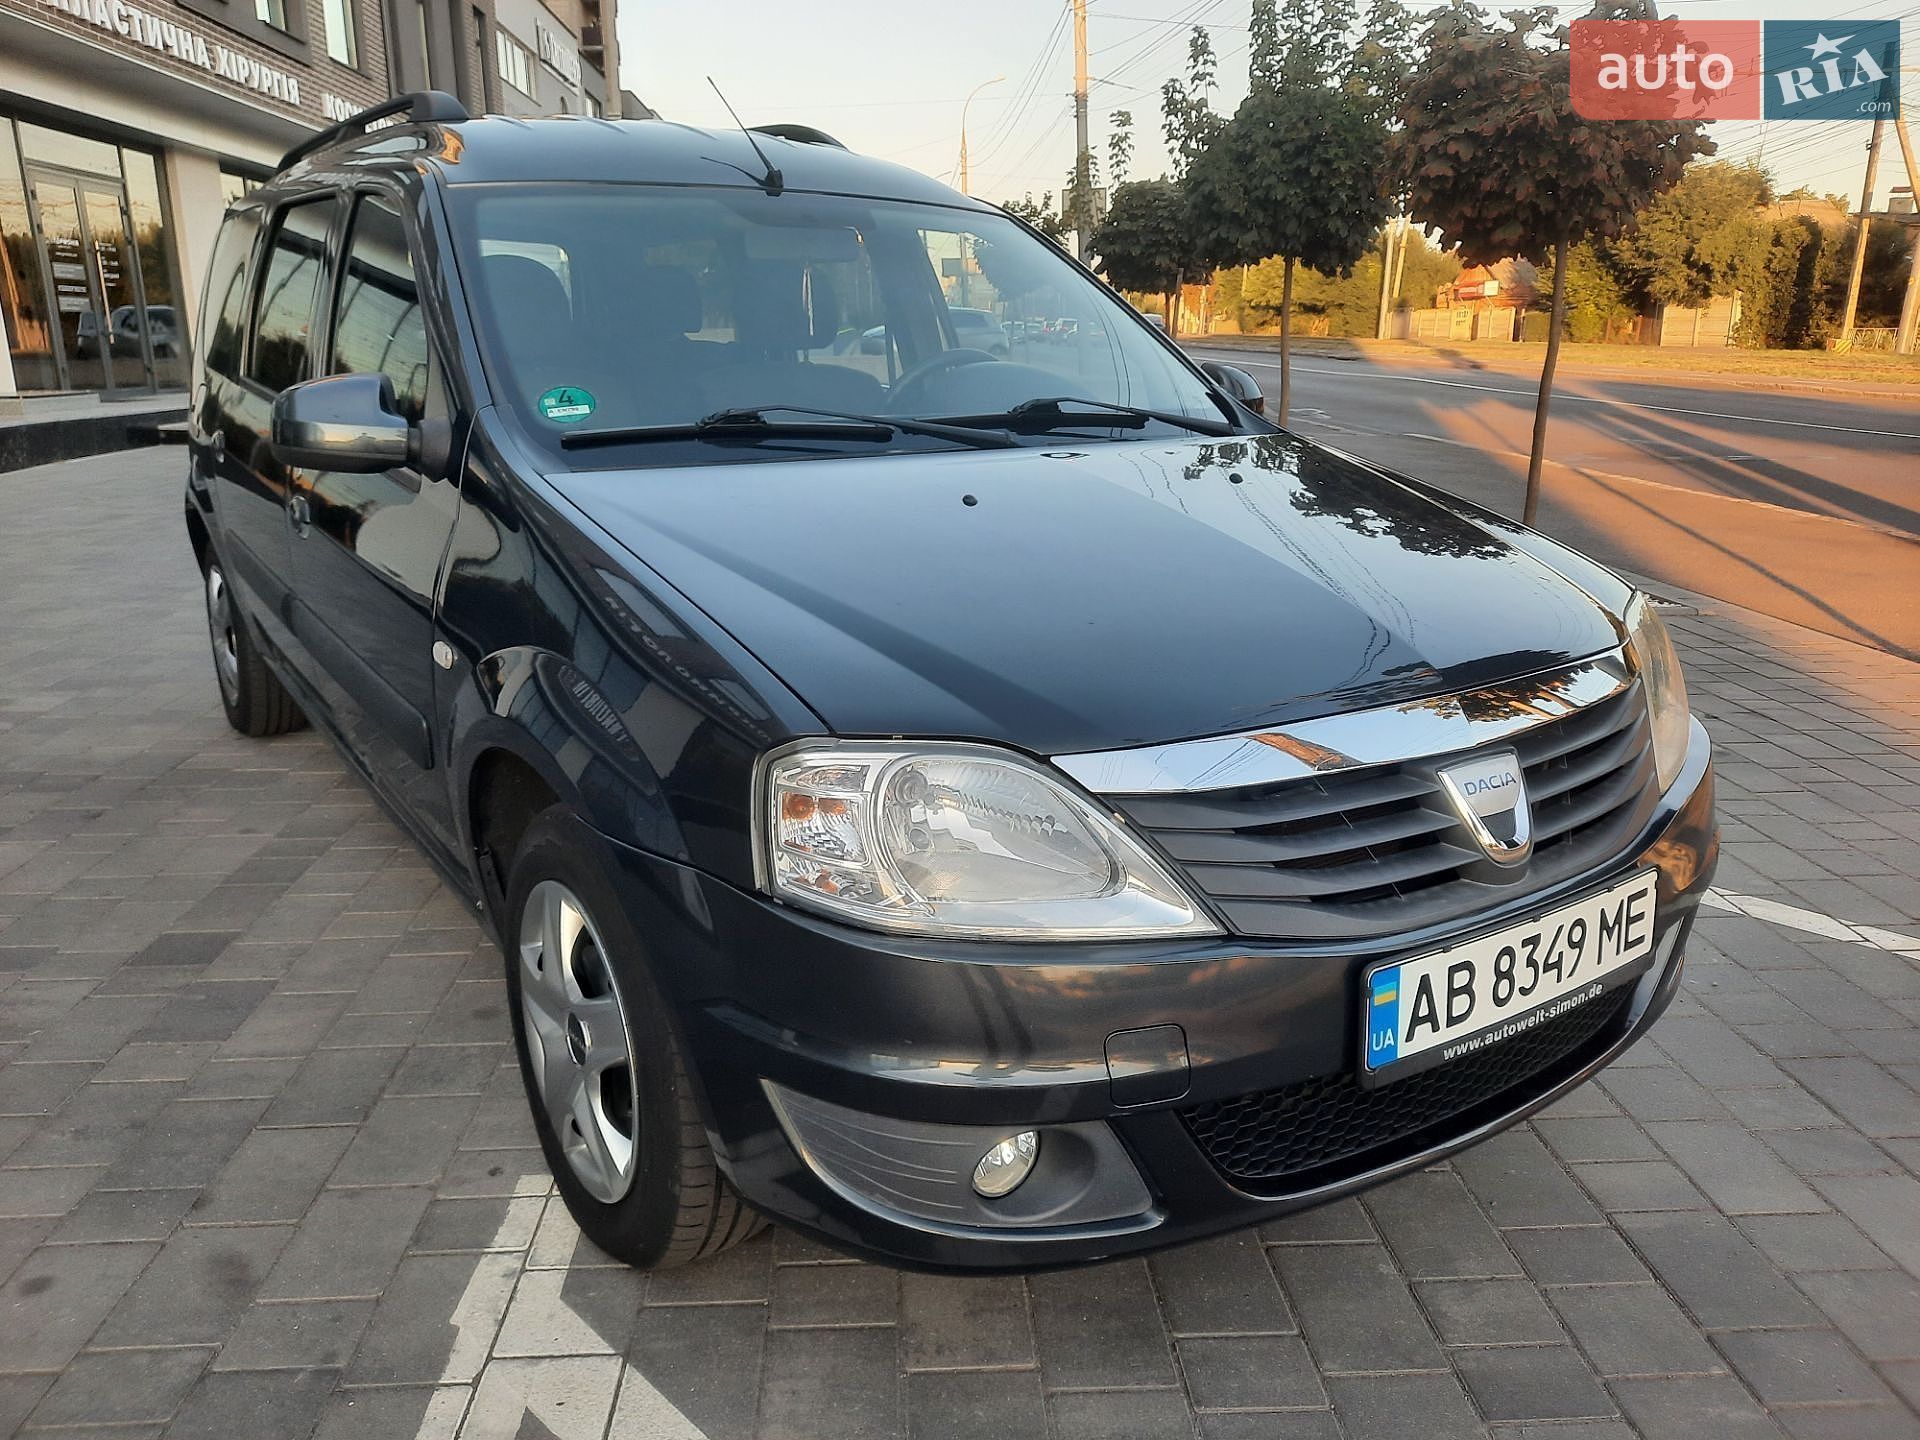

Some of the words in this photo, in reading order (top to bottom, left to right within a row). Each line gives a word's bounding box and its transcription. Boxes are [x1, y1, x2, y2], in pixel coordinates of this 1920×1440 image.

[215, 45, 301, 106] ХІРУРГІЯ
[557, 389, 574, 404] 4
[1463, 771, 1517, 797] DACIA
[1404, 959, 1477, 1043] AB
[1492, 917, 1588, 1009] 8349
[1597, 887, 1649, 966] ME
[1371, 1031, 1395, 1052] UA
[1443, 981, 1604, 1061] www.autowelt-simon.de
